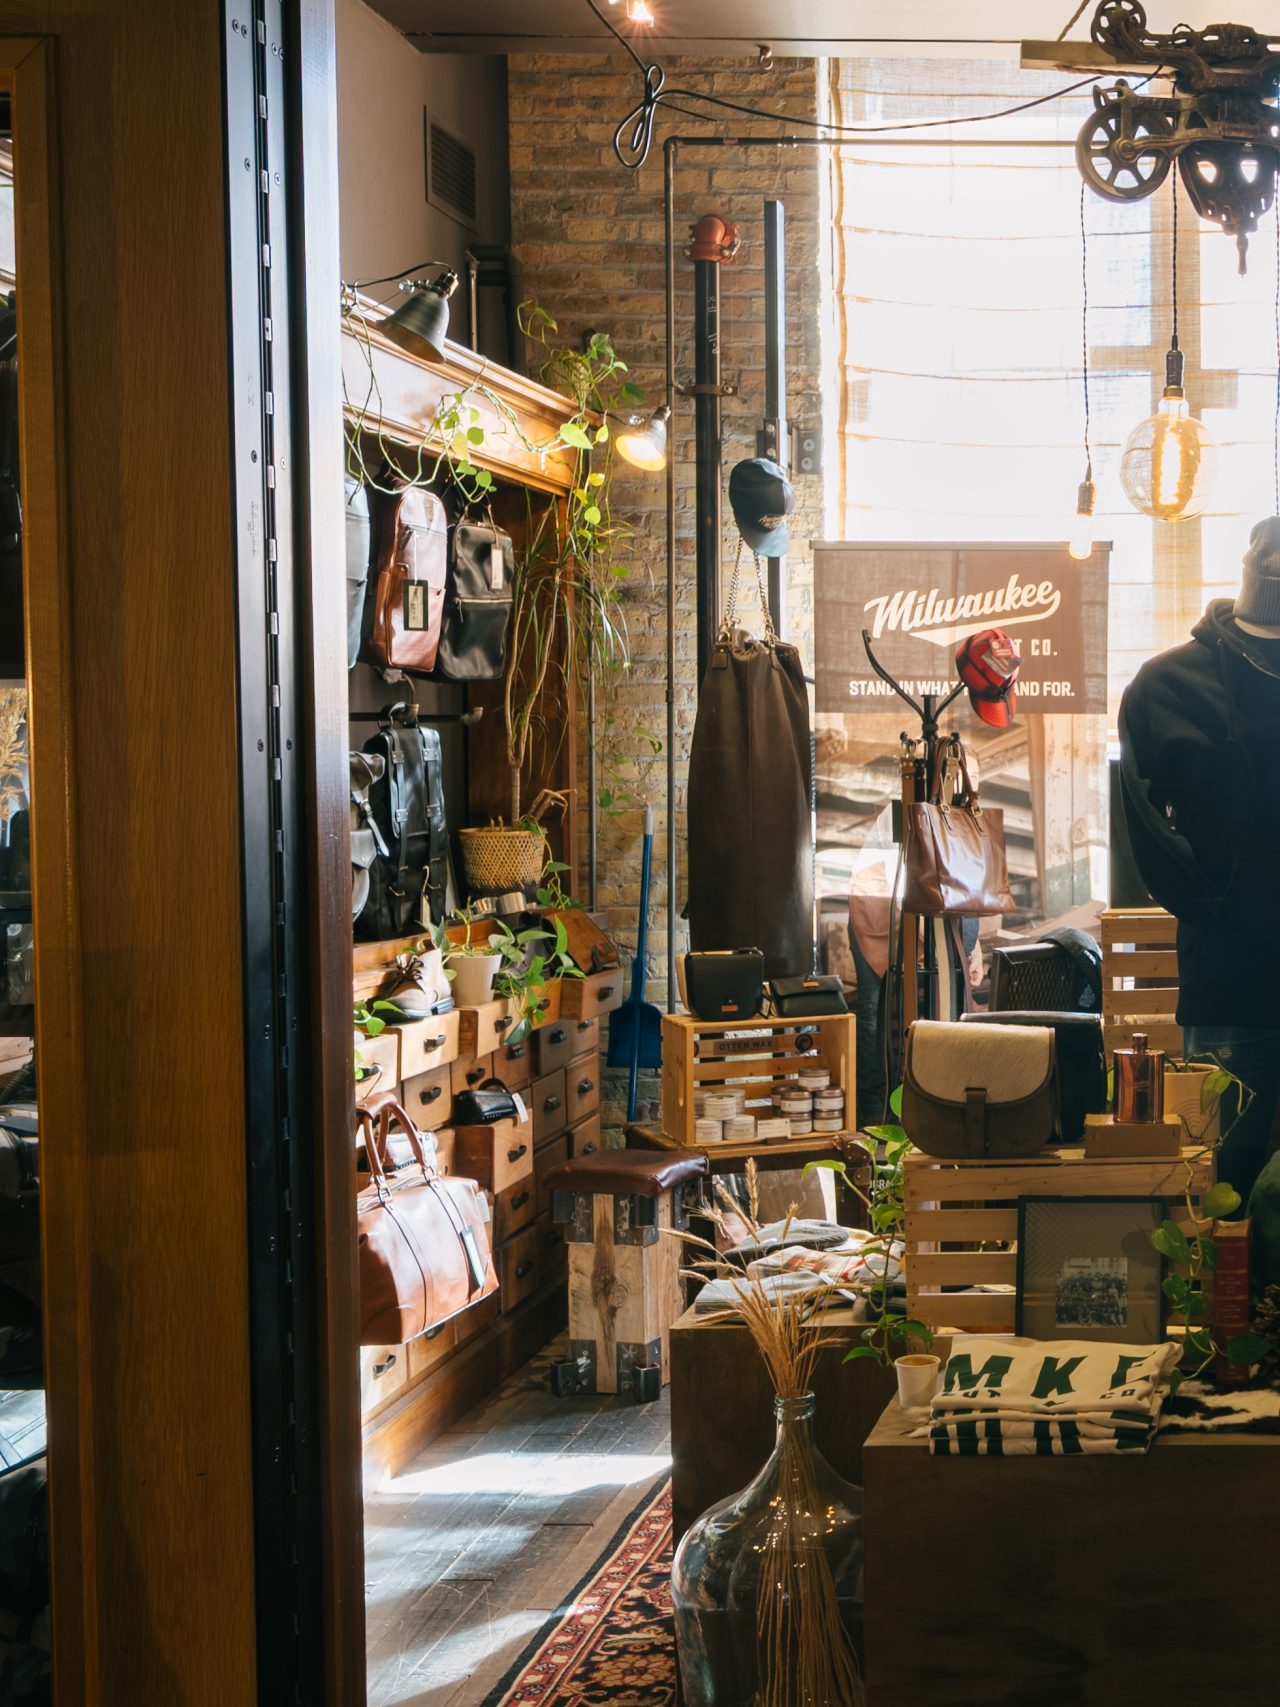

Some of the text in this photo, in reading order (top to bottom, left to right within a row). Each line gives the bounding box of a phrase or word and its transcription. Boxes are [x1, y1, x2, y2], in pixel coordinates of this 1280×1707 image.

[864, 574, 1060, 638] Milwaukee
[1031, 639, 1058, 656] CO.
[1043, 682, 1075, 696] FOR.
[719, 1040, 774, 1051] OTTER WAX
